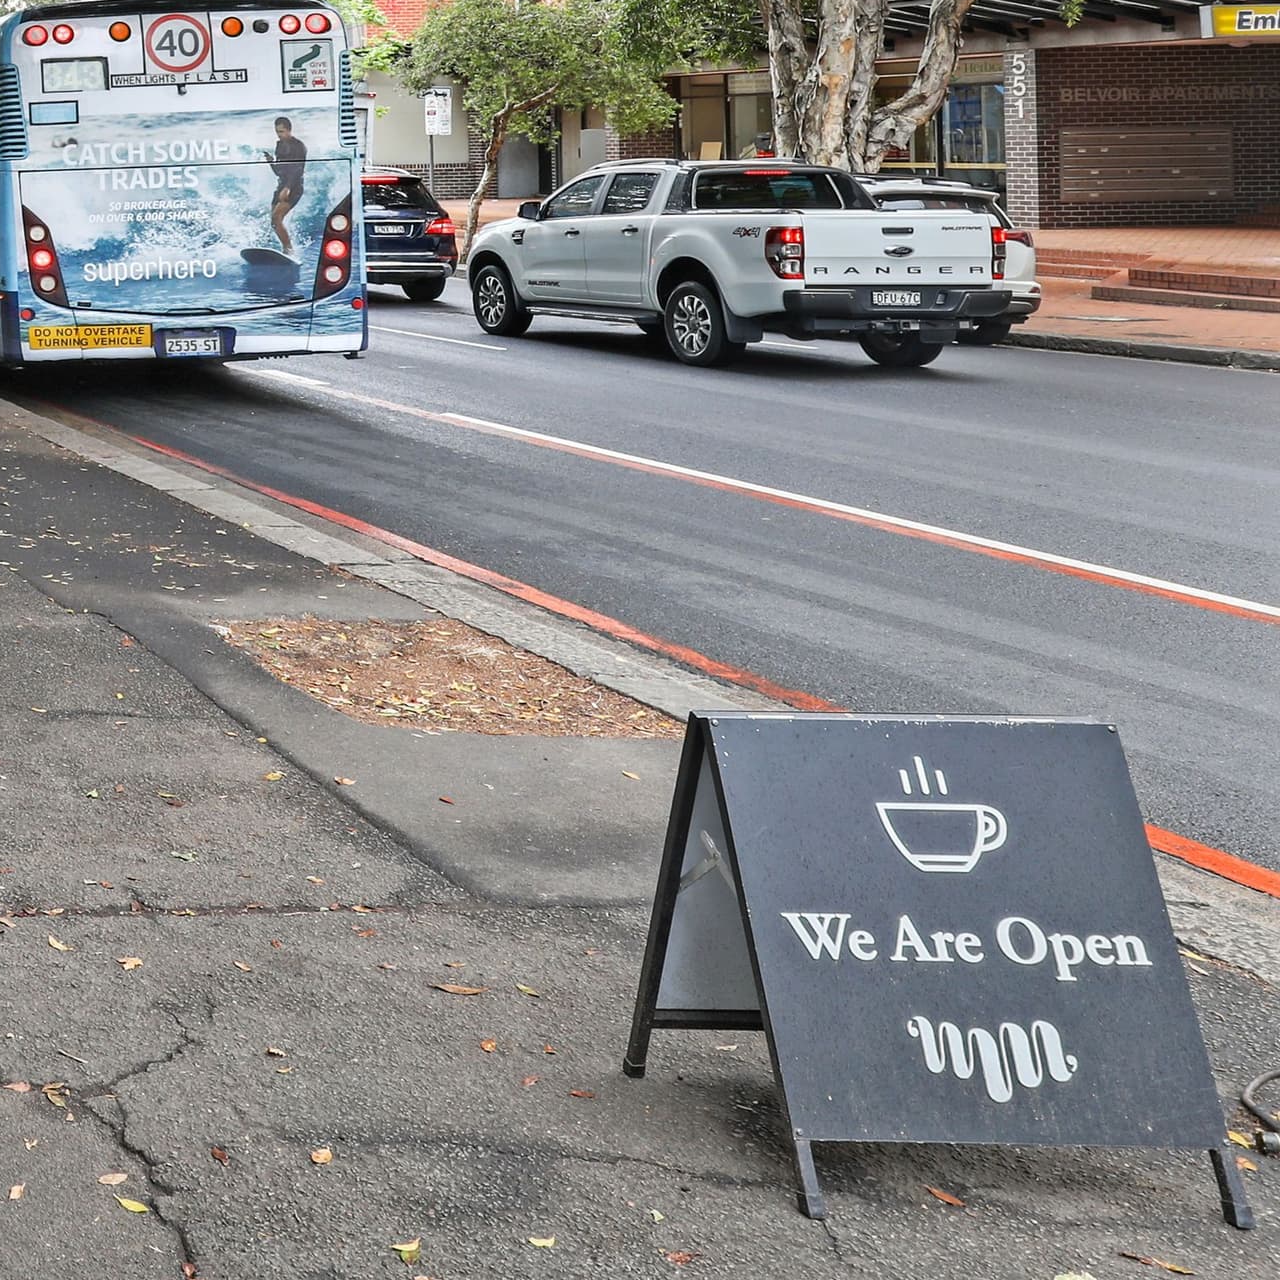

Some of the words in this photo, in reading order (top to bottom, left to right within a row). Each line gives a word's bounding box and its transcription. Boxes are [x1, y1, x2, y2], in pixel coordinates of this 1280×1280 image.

[1236, 10, 1280, 31] Em
[155, 28, 200, 57] 40
[113, 76, 140, 85] WHEN
[144, 74, 177, 84] LIGHTS
[183, 72, 244, 82] FLASH
[1011, 54, 1027, 119] 551
[1060, 87, 1140, 103] BELVOIR
[1150, 84, 1280, 100] APARTMENTS
[62, 143, 145, 167] CATCH
[152, 139, 231, 163] SOME
[93, 168, 199, 191] TRADES
[124, 199, 187, 211] BROKERAGE
[90, 214, 105, 224] ON
[106, 213, 134, 222] OVER
[166, 210, 209, 221] SHARES
[83, 256, 217, 286] superhero
[813, 266, 984, 274] RANGER
[34, 328, 51, 337] DO
[56, 327, 80, 337] NOT
[85, 327, 145, 337] OVERTAKE
[37, 337, 89, 347] TURNING
[92, 336, 143, 346] VEHICLE
[781, 912, 878, 962] We
[890, 914, 984, 965] Are
[996, 916, 1153, 982] Open
